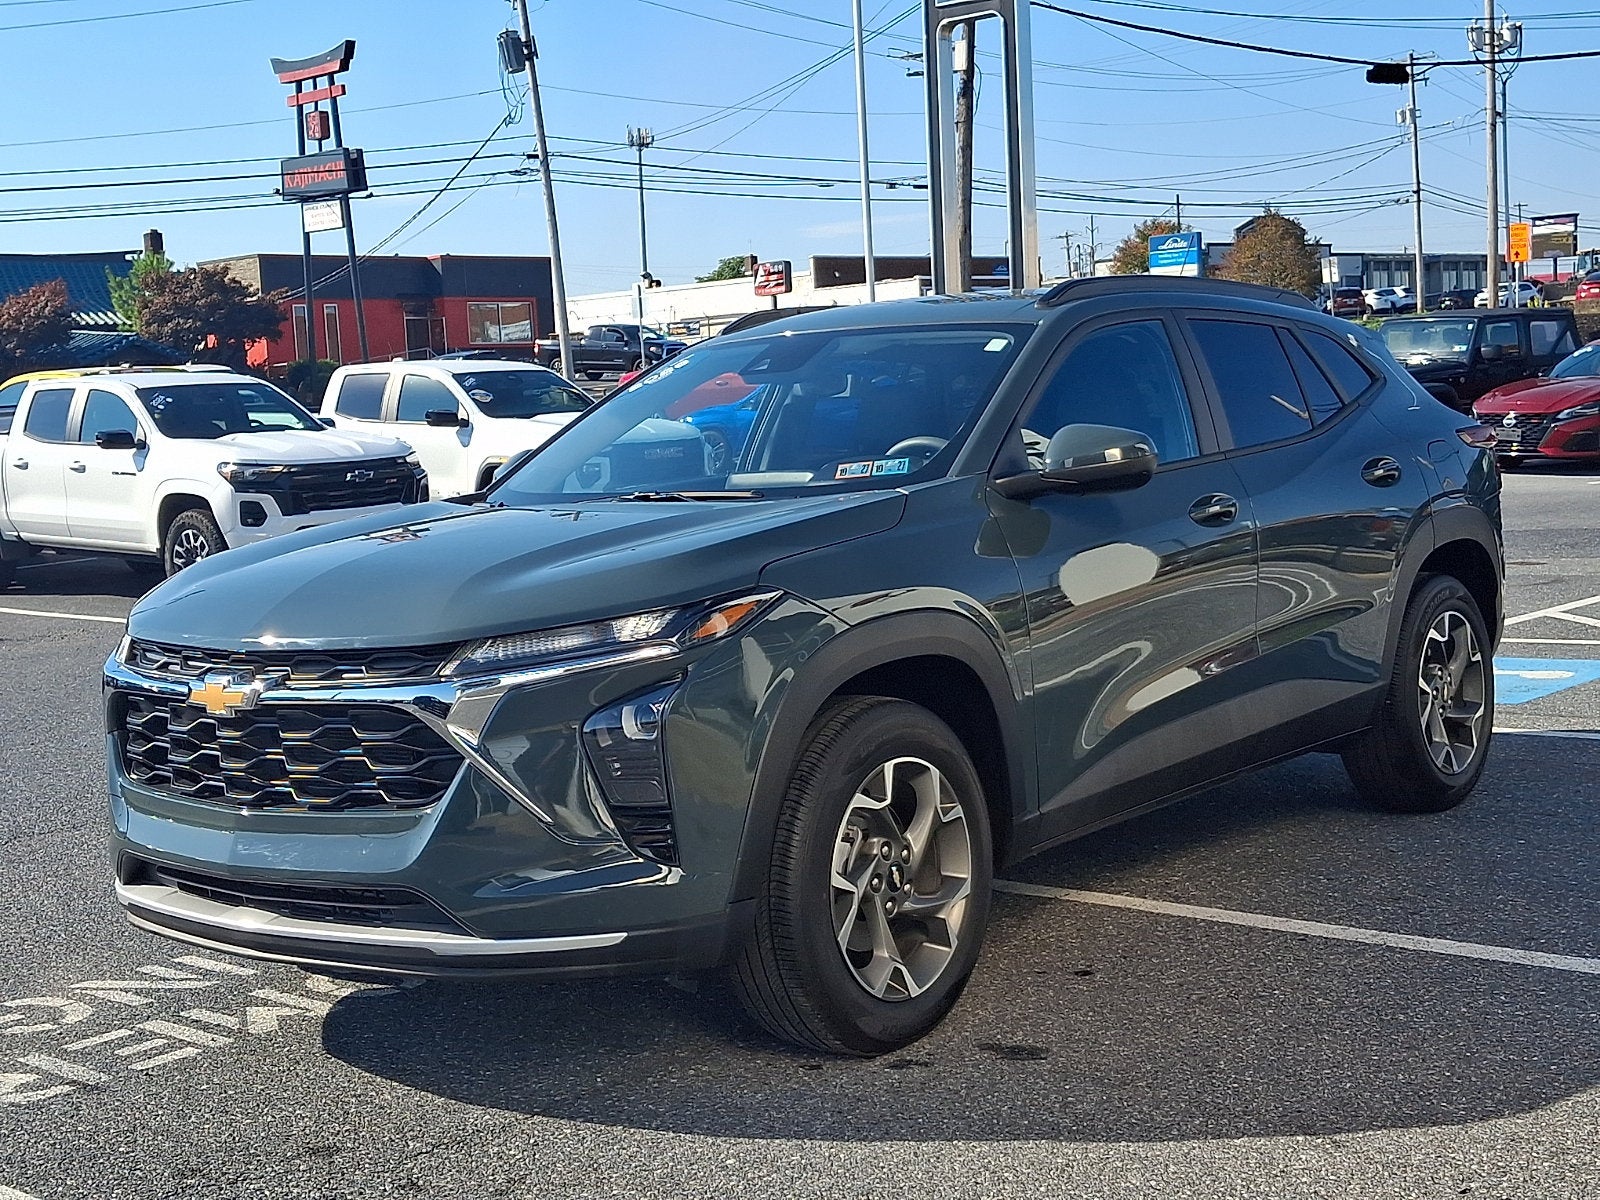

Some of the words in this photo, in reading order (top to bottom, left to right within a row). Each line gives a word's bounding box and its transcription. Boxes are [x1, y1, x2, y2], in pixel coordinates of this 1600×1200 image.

[285, 161, 344, 188] KAJIMACHI
[1158, 237, 1187, 249] Linde
[861, 464, 870, 473] 27
[897, 461, 906, 471] 27
